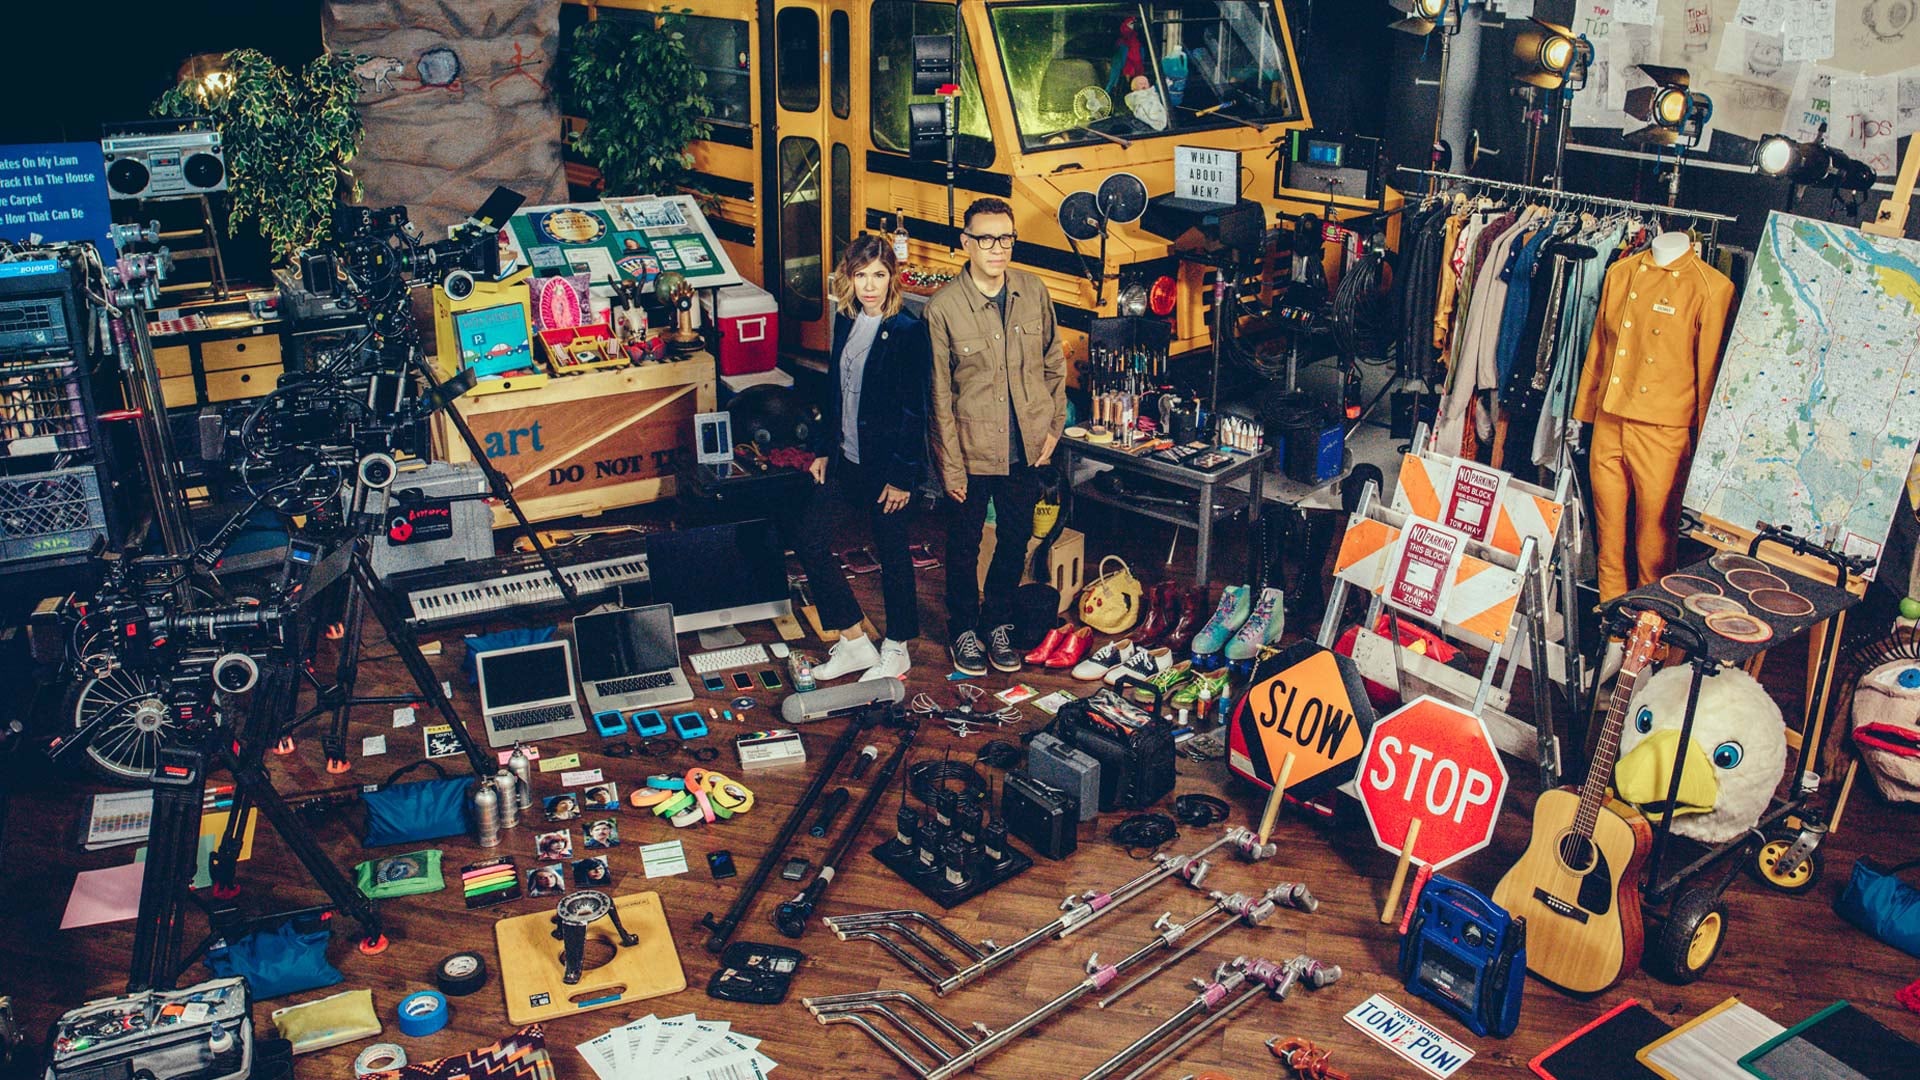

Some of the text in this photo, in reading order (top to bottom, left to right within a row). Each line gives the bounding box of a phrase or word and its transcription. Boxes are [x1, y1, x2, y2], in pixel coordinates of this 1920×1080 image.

[1846, 113, 1892, 149] Tips
[22, 157, 36, 168] On
[37, 156, 52, 170] My
[53, 155, 79, 167] Lawn
[1190, 152, 1219, 165] WHAT
[23, 175, 32, 187] It
[34, 175, 45, 186] In
[45, 173, 63, 185] The
[65, 172, 95, 184] House
[1189, 168, 1223, 182] ABOUT
[9, 193, 43, 207] Carpet
[1191, 185, 1219, 198] MEN?
[5, 213, 26, 225] How
[27, 210, 50, 223] That
[51, 209, 70, 220] Can
[71, 208, 84, 218] Be
[484, 419, 545, 459] art
[548, 464, 585, 486] DO
[594, 455, 643, 479] NOT
[1457, 467, 1497, 490] NO PARKING
[1457, 483, 1493, 500] THIS BLOCK
[409, 509, 449, 521] Amore
[1449, 518, 1482, 535] TOW AWAY
[1410, 525, 1454, 551] NO PARKING
[1409, 542, 1447, 562] THIS BLOCK
[1398, 581, 1435, 601] TOW AWAY
[1403, 593, 1423, 607] ZONE
[1260, 679, 1353, 760] SLOW
[1369, 735, 1493, 824] STOP
[1393, 1010, 1443, 1042] NEW YORK
[1357, 1002, 1461, 1072] TONI PONI
